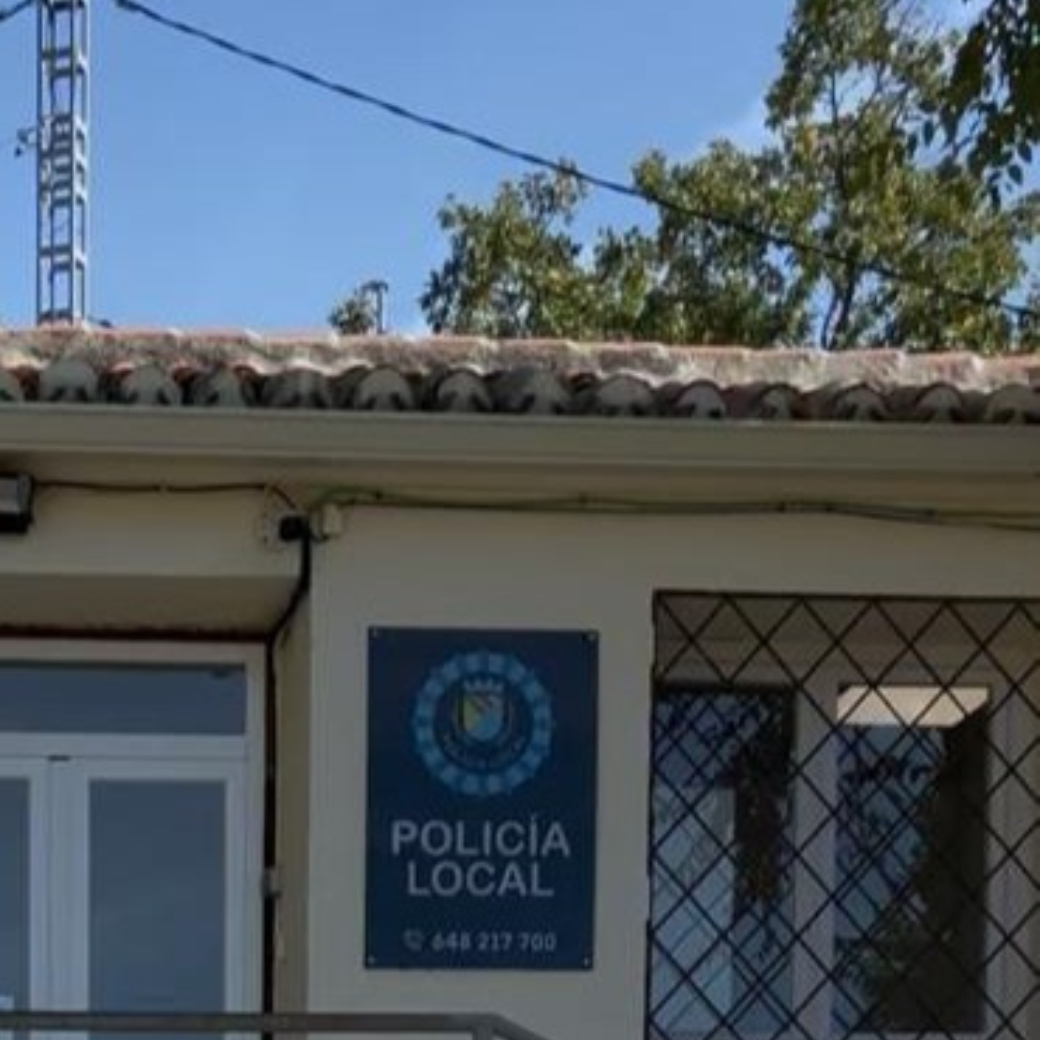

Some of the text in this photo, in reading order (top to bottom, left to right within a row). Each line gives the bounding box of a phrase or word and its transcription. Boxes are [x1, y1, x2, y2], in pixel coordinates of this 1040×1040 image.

[391, 814, 570, 857] POLICÍA
[407, 861, 555, 897] LOCAL
[478, 931, 514, 952] 217
[519, 931, 558, 952] 700
